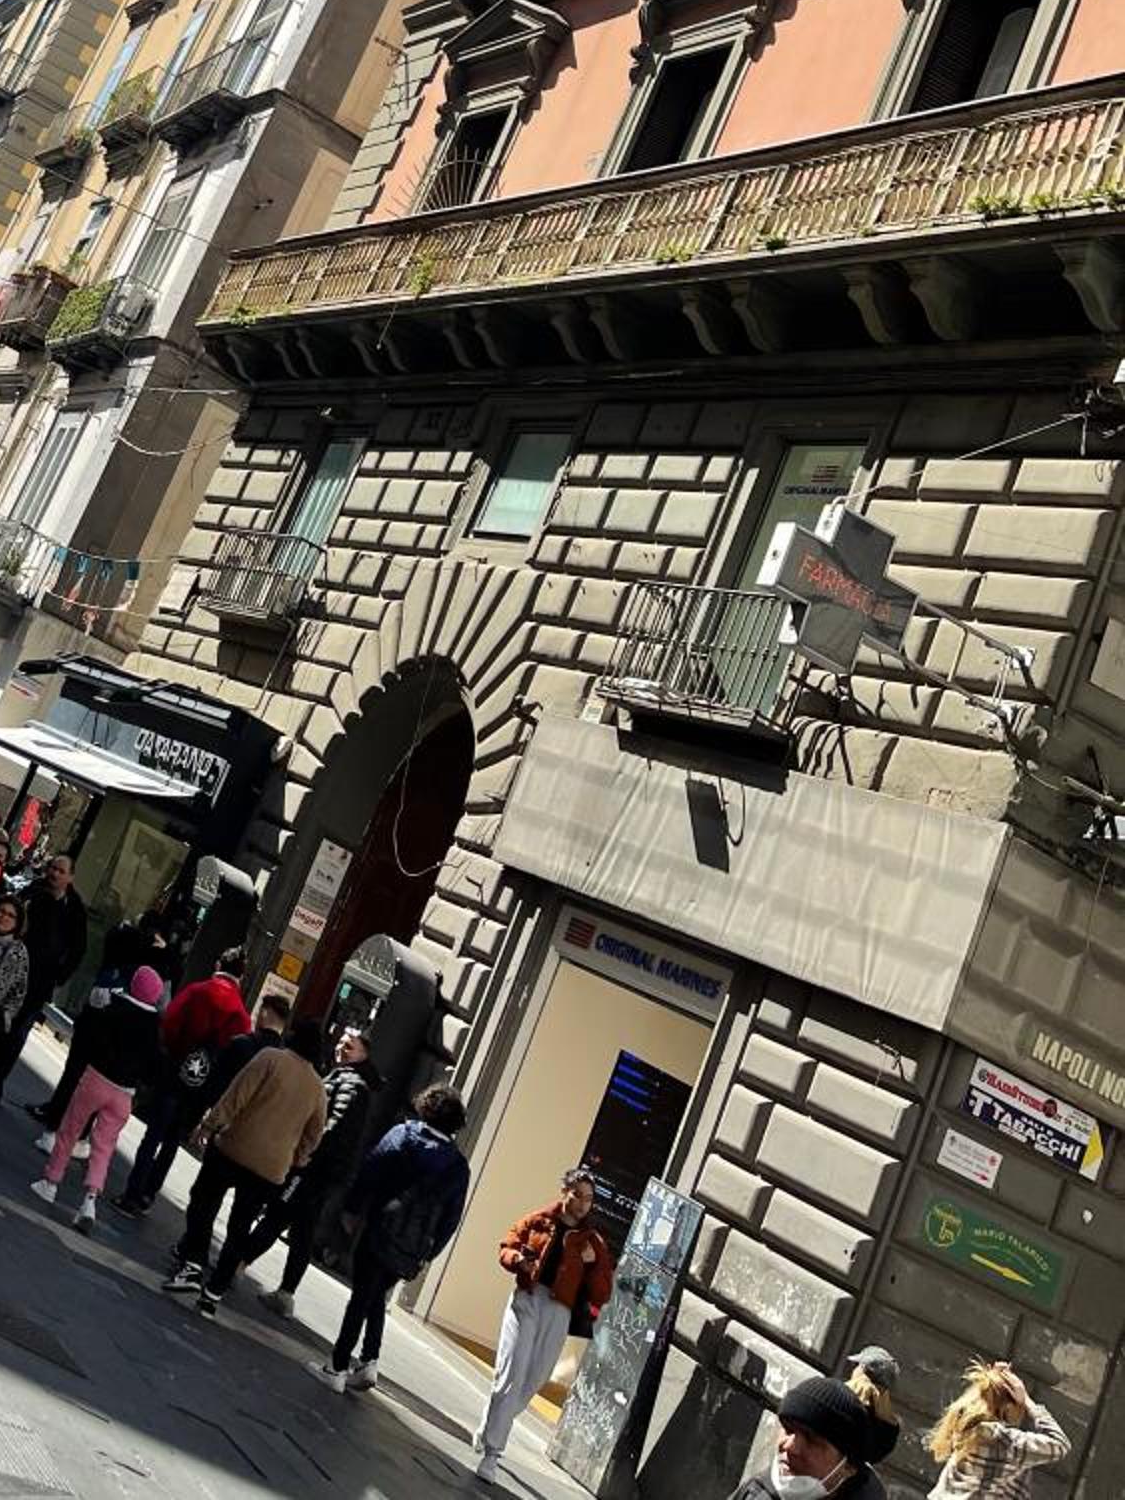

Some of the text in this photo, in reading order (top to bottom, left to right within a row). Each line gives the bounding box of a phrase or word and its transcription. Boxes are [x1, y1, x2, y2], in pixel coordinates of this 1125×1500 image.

[1032, 1031, 1125, 1109] NAPOLI NO
[992, 1101, 1081, 1162] TABACCHI
